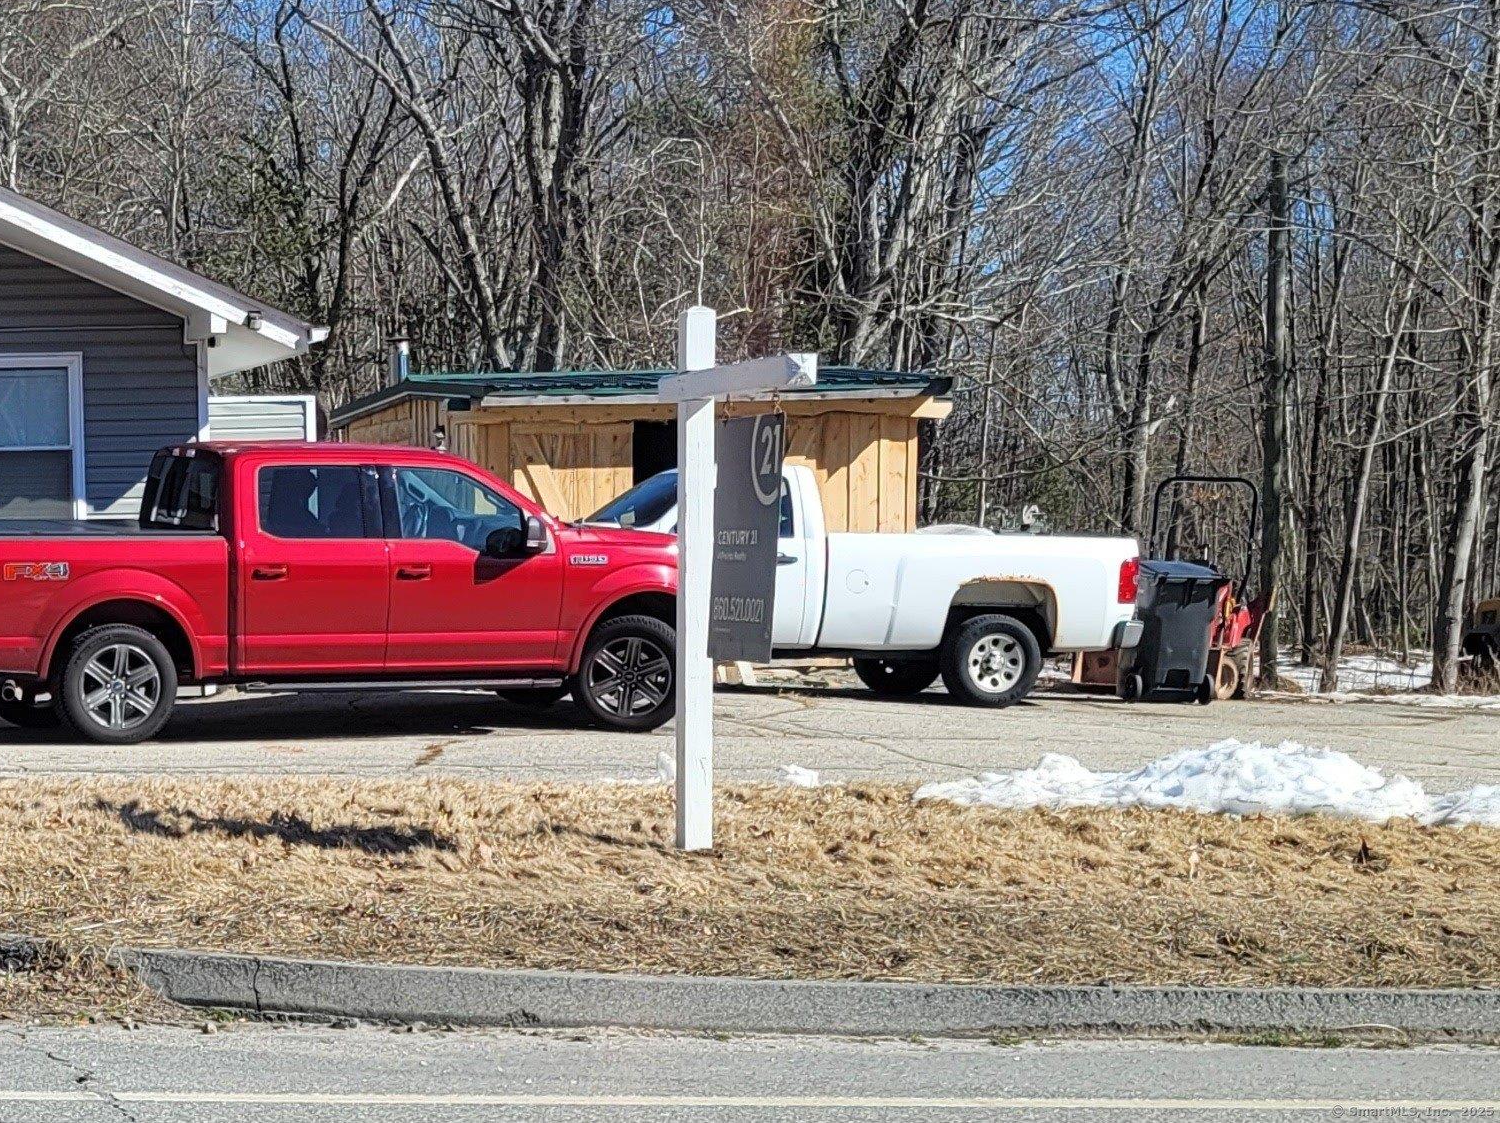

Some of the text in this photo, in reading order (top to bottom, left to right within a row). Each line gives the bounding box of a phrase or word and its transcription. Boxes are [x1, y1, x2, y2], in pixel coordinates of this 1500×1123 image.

[760, 425, 781, 474] 21
[717, 529, 758, 545] CENTURY 21
[3, 562, 69, 580] FX4
